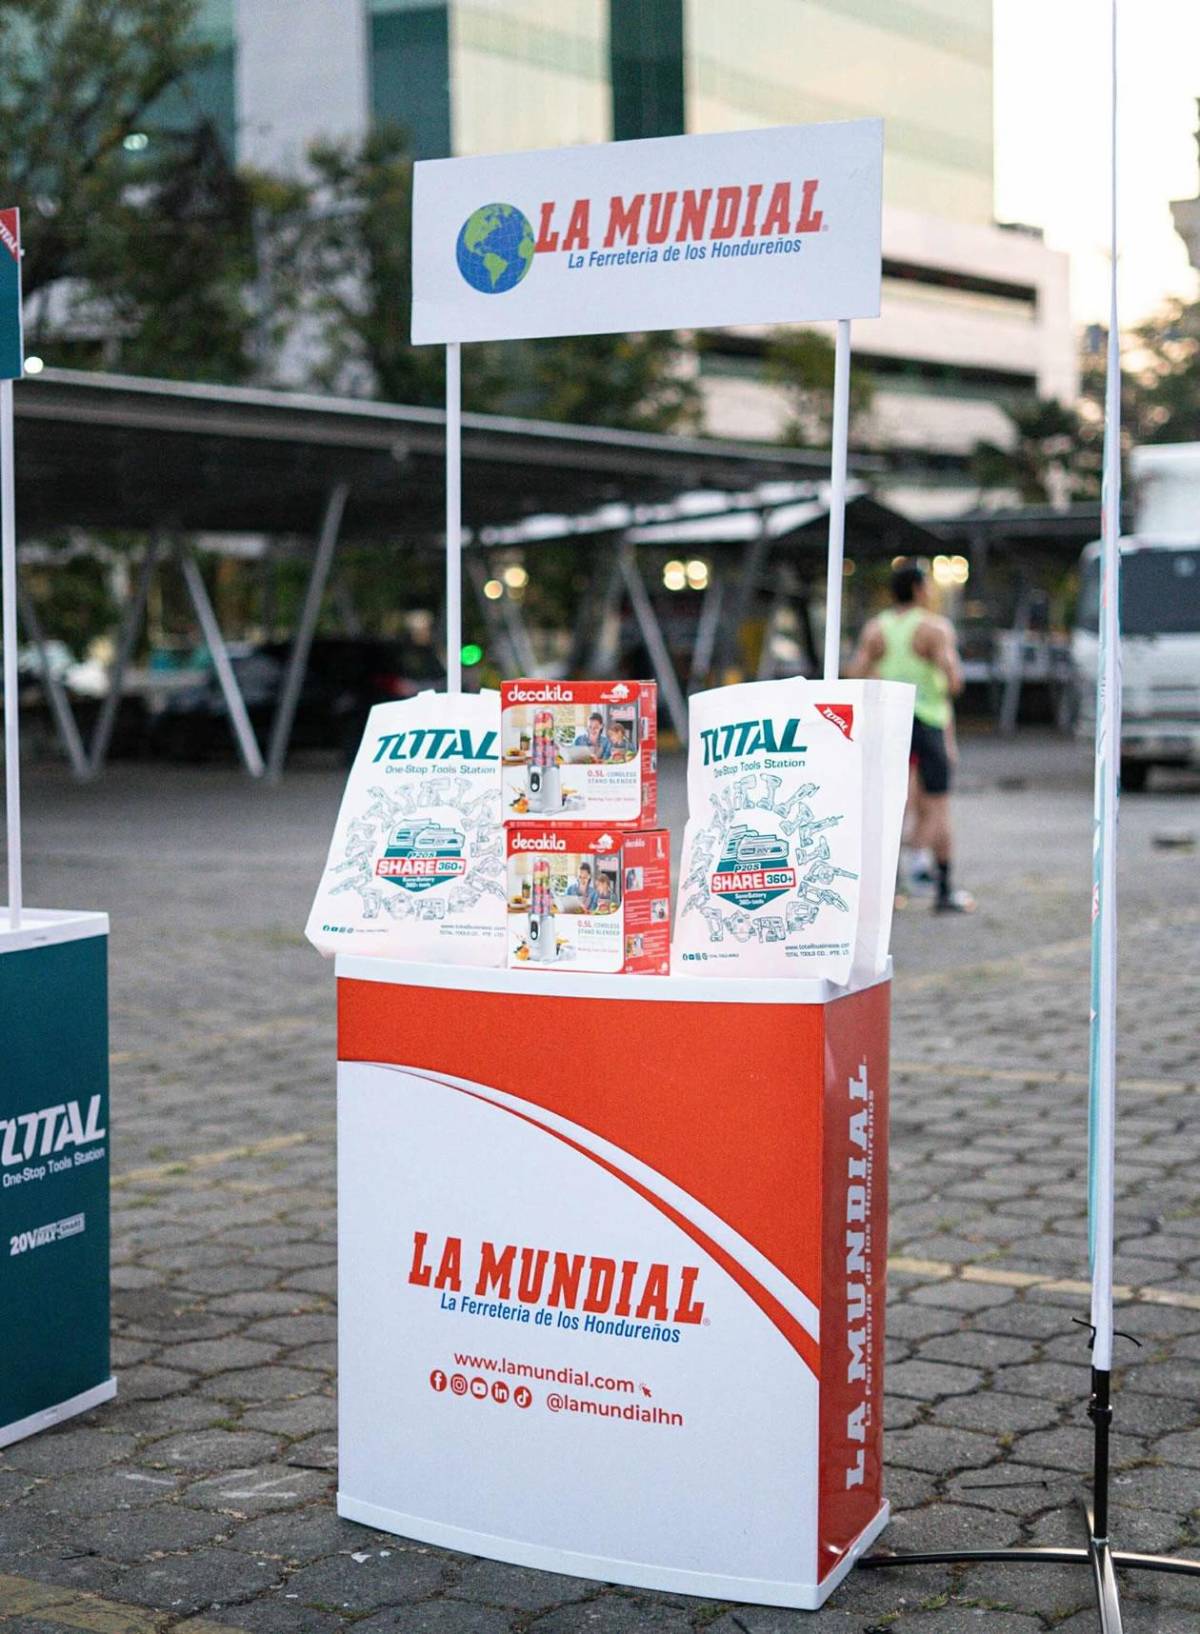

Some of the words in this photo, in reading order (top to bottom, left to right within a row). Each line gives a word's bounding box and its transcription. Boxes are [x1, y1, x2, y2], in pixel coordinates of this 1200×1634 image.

[534, 199, 590, 253] LA
[603, 179, 823, 248] MUNDIAL
[568, 253, 584, 269] La
[663, 245, 680, 262] de
[685, 243, 706, 260] los
[711, 237, 802, 258] Hondureños
[508, 685, 573, 702] decakila
[822, 705, 849, 732] TOTAL
[372, 729, 500, 763] TOTAL
[700, 719, 808, 766] TOTAL
[385, 765, 428, 777] One-Stop
[431, 765, 457, 774] Tools
[459, 765, 496, 775] Station
[741, 760, 761, 772] Tools
[764, 759, 806, 769] Station
[512, 832, 566, 850] decakila
[377, 860, 435, 875] SHARE
[438, 862, 463, 871] 360+
[712, 873, 763, 891] SHARE
[766, 874, 793, 885] 360+
[3, 1165, 46, 1188] One-Stop
[48, 1155, 72, 1175] Tools
[74, 1147, 106, 1167] Station
[846, 1064, 868, 1384] MUNDIAL
[408, 1231, 462, 1292] LA
[475, 1241, 705, 1325] MUNDIAL
[440, 1292, 456, 1310] La
[535, 1308, 553, 1326] de
[557, 1311, 580, 1330] los
[584, 1315, 681, 1343] Hondureños
[454, 1353, 635, 1393] www.lamundial.com
[547, 1393, 683, 1426] @lamundialhn
[846, 1401, 866, 1489] LA
